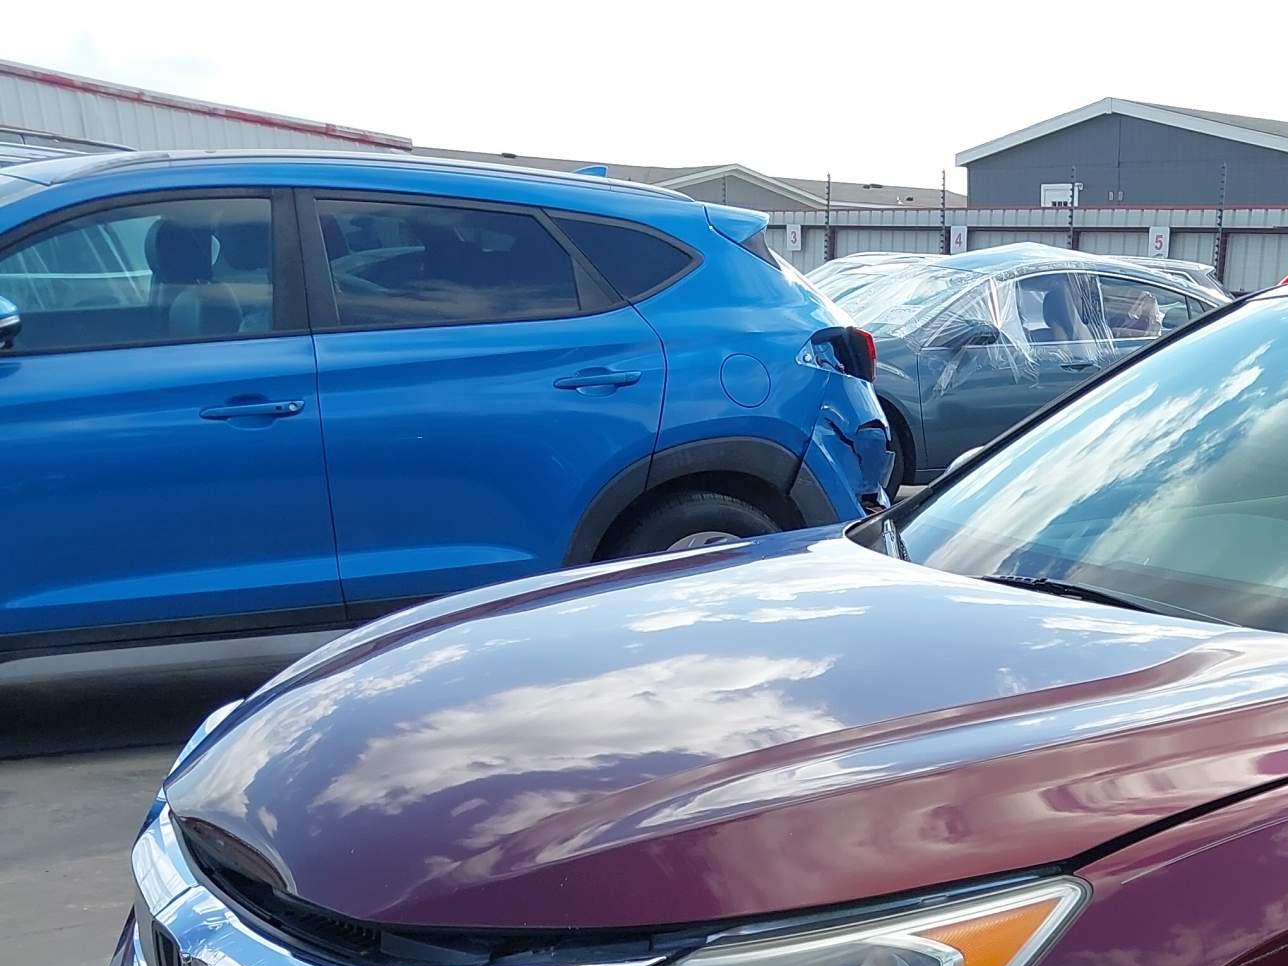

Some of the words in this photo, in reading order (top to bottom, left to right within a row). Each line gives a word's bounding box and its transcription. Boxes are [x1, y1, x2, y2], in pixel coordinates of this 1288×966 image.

[791, 231, 797, 244] 3
[955, 233, 962, 247] 4
[1154, 235, 1163, 250] 5
